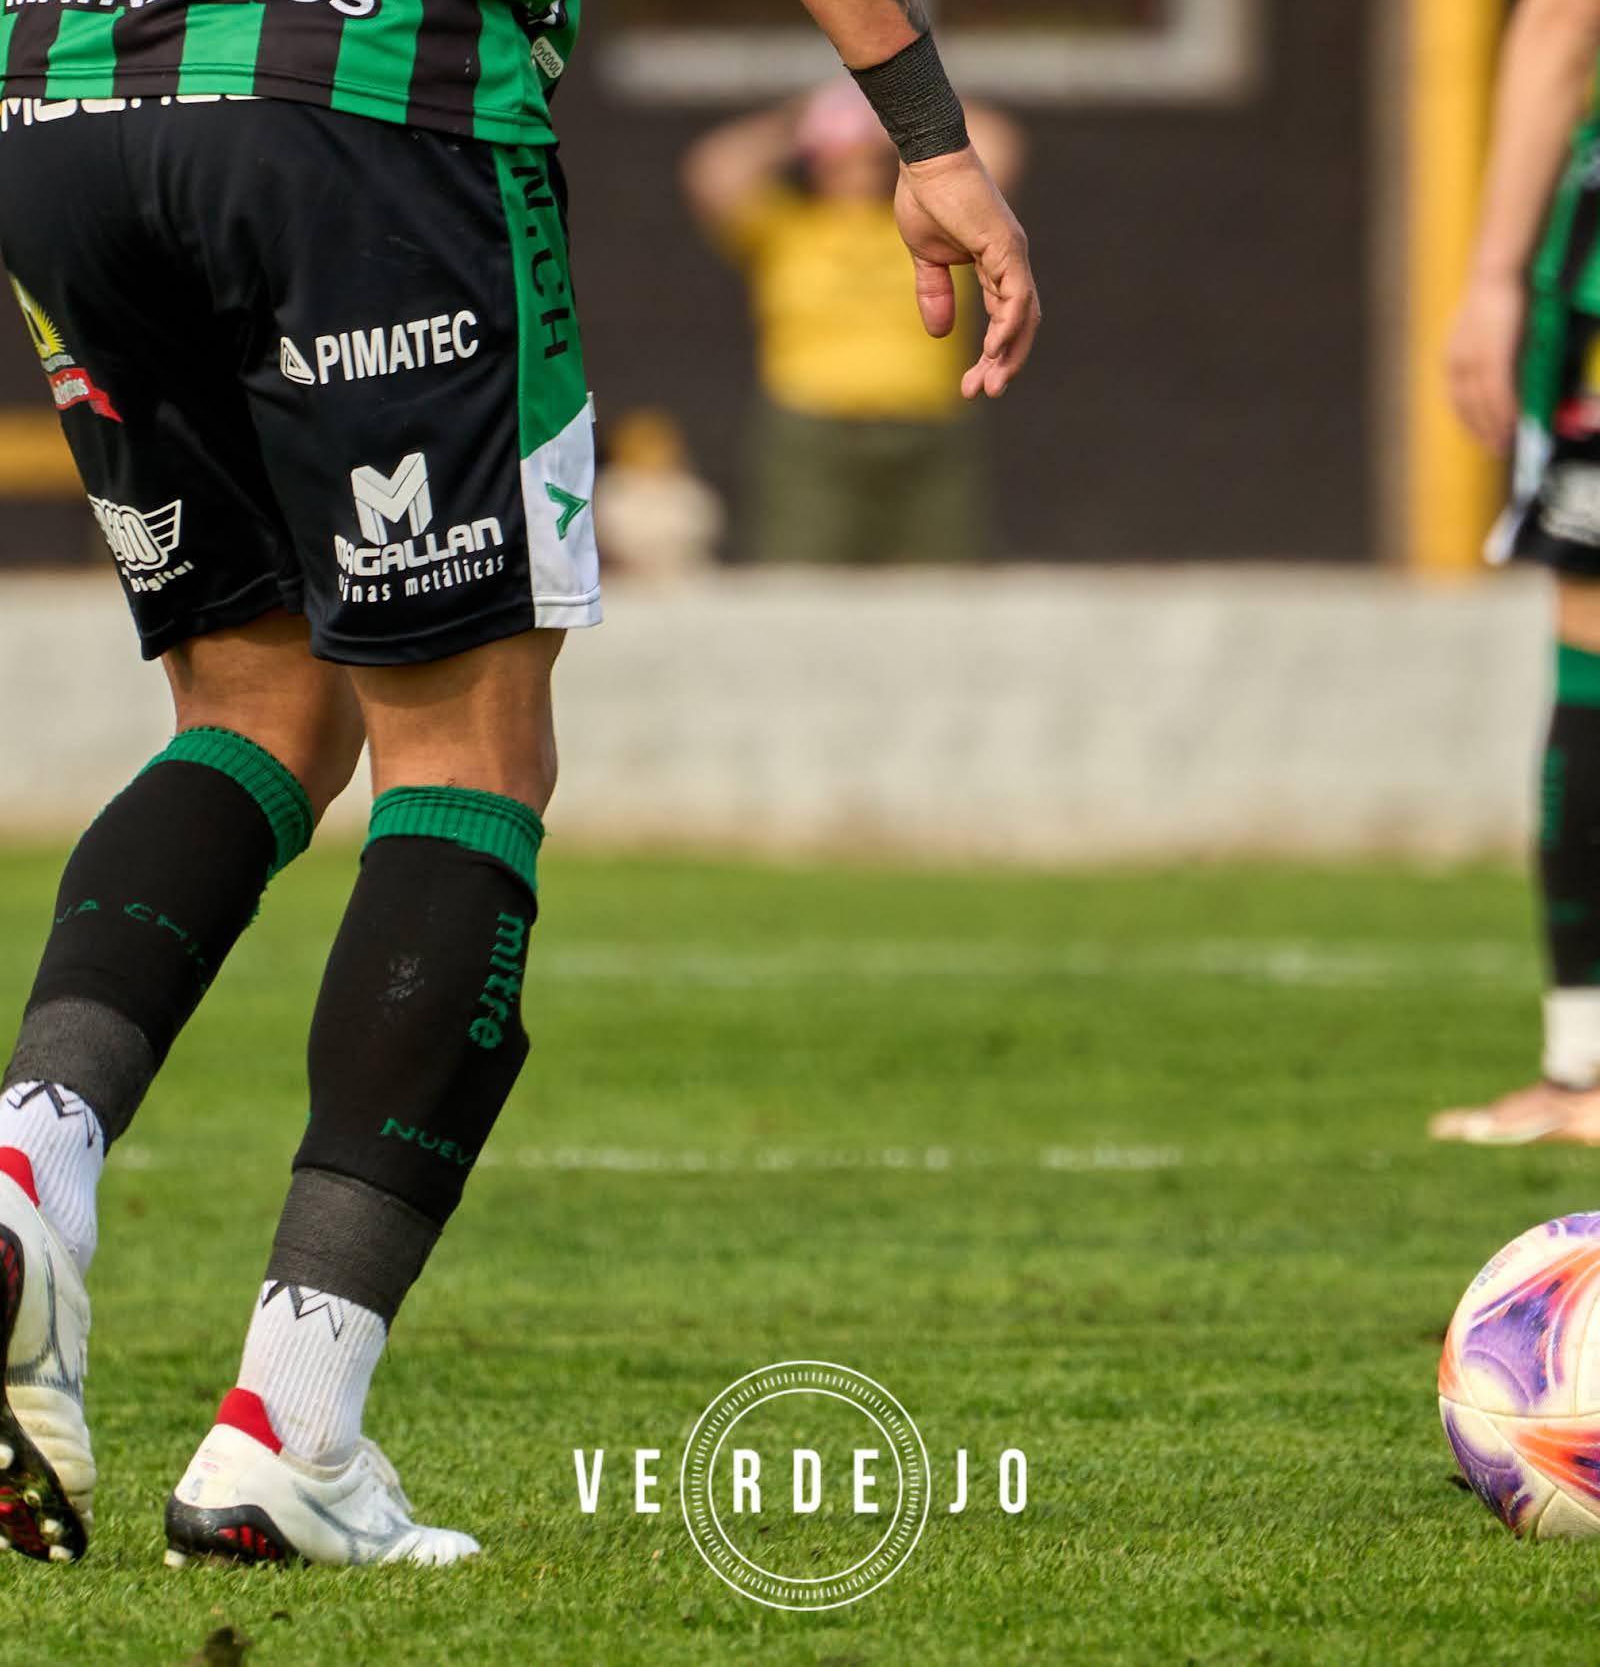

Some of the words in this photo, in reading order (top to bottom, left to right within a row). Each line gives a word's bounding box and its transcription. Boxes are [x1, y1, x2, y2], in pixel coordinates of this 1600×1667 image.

[315, 310, 479, 385] PIMATEC
[405, 554, 504, 597] metálicas
[468, 912, 525, 1049] mitre
